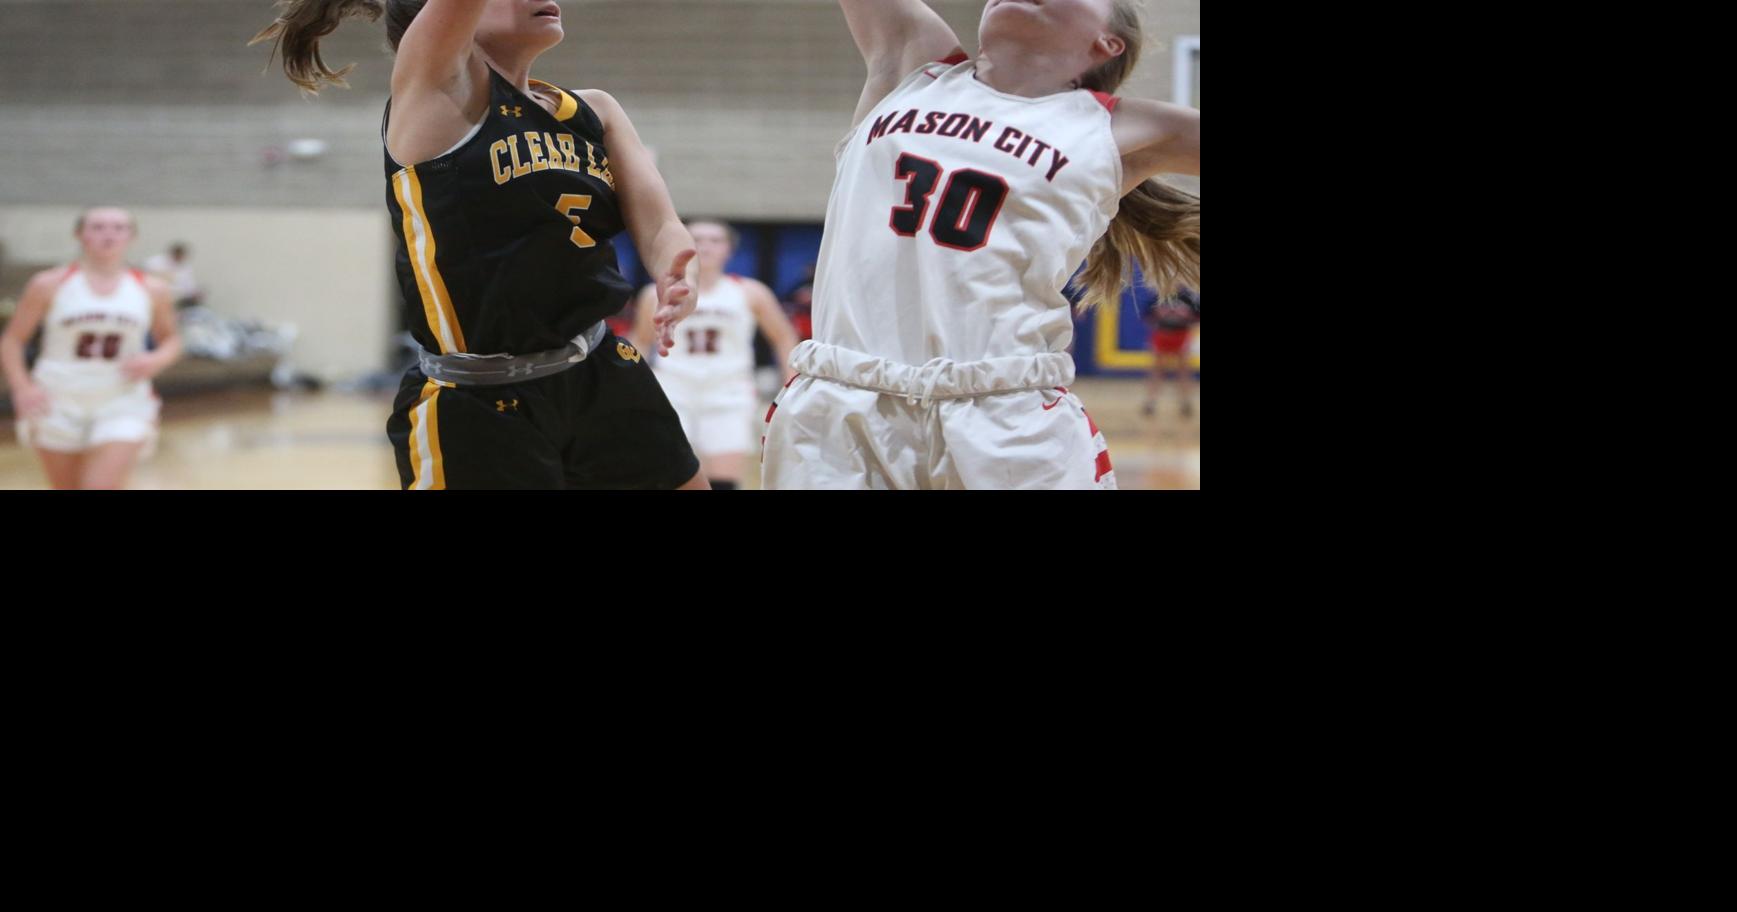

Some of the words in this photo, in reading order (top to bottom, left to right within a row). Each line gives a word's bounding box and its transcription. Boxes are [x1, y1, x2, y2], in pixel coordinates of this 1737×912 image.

[490, 131, 580, 185] CLEAR
[867, 109, 992, 146] MASON
[993, 126, 1069, 182] CITY
[554, 193, 596, 248] 5
[889, 152, 1010, 252] 30
